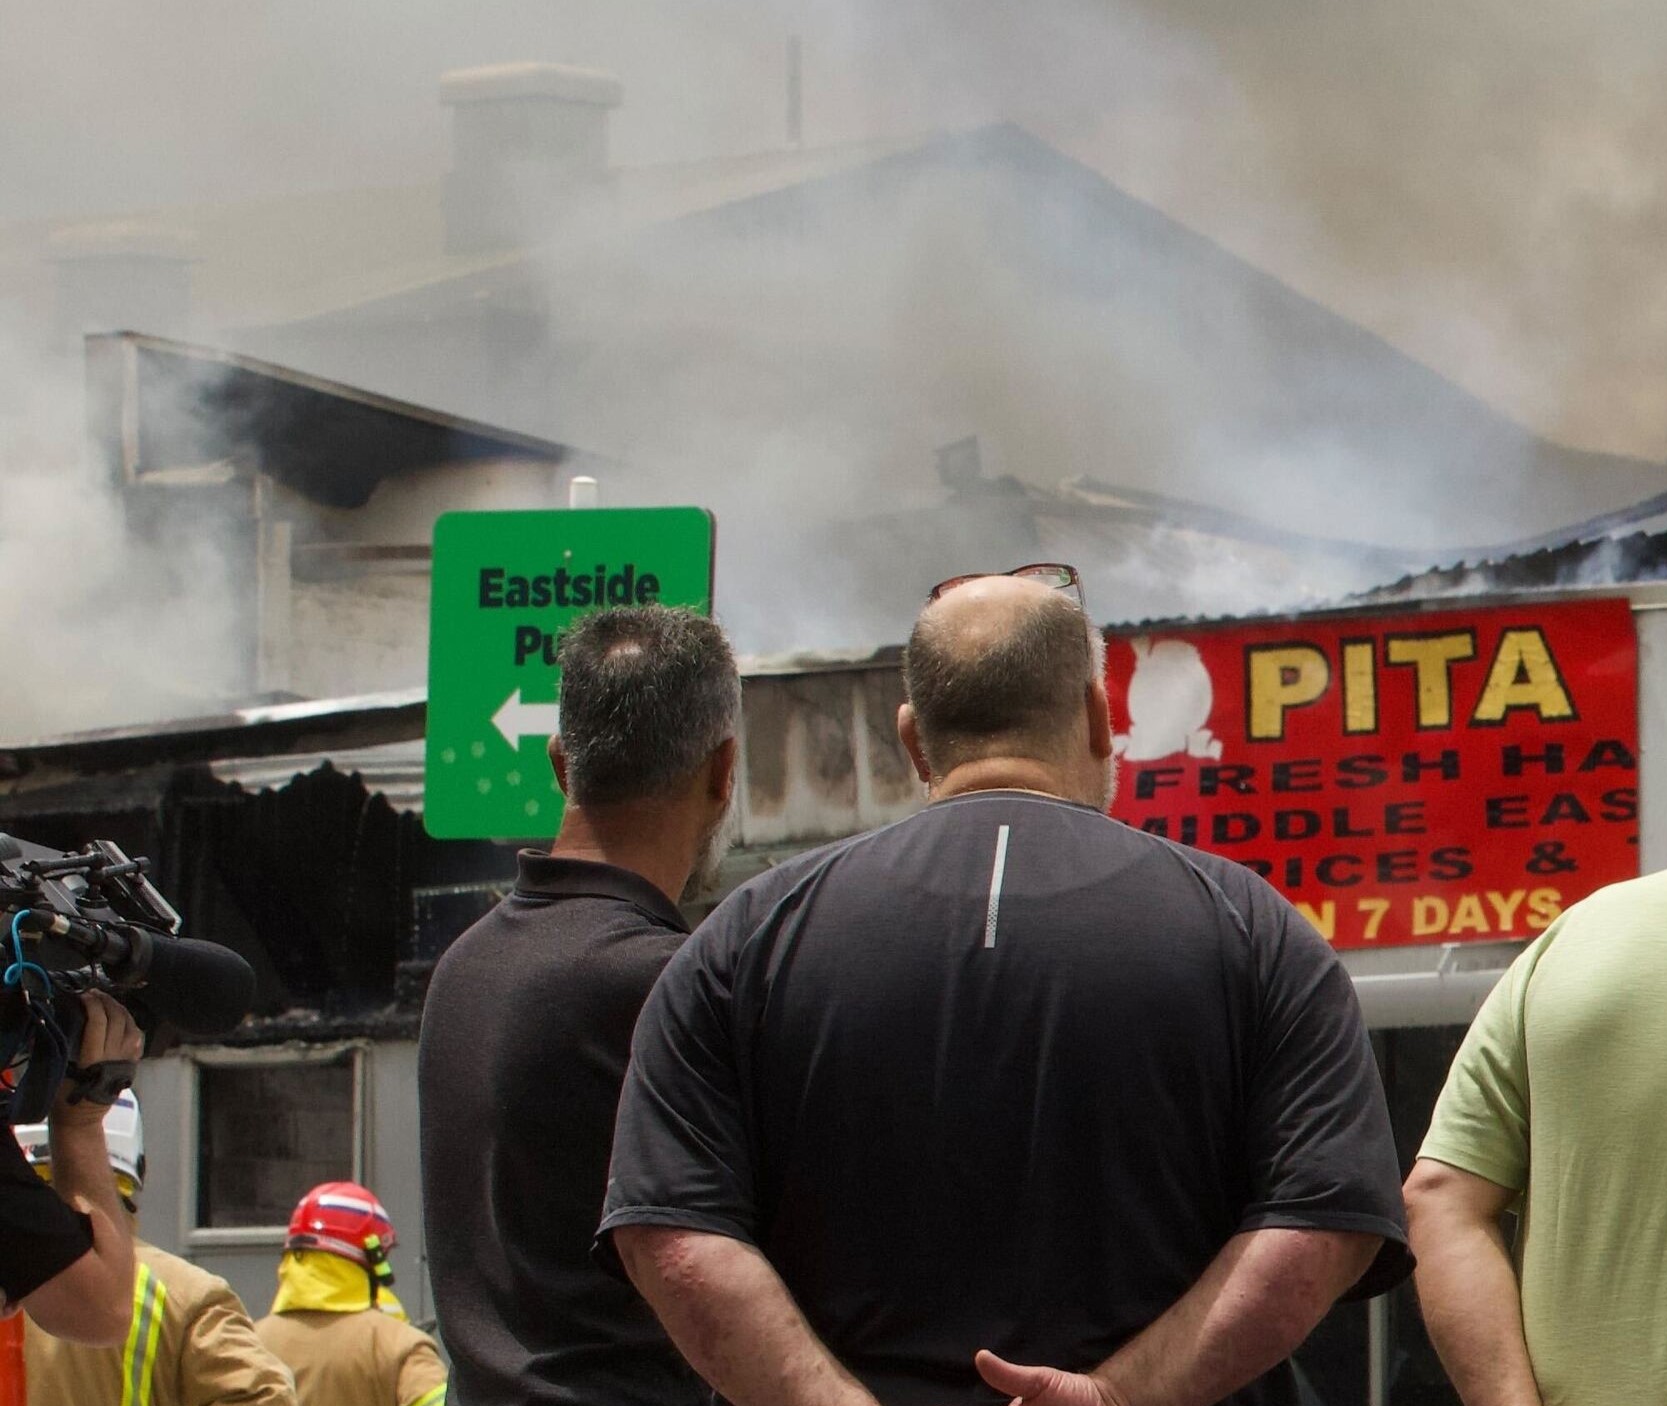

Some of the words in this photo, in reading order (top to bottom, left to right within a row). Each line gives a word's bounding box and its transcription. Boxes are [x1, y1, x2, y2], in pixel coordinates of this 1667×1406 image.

[478, 564, 661, 609] Eastside
[1244, 624, 1581, 744] PITA
[1134, 750, 1462, 799] FRESH
[1503, 739, 1637, 776] HA
[1485, 788, 1638, 830] EAS
[1525, 840, 1578, 876] &
[1358, 898, 1390, 940] 7
[1412, 887, 1562, 936] DAYS
